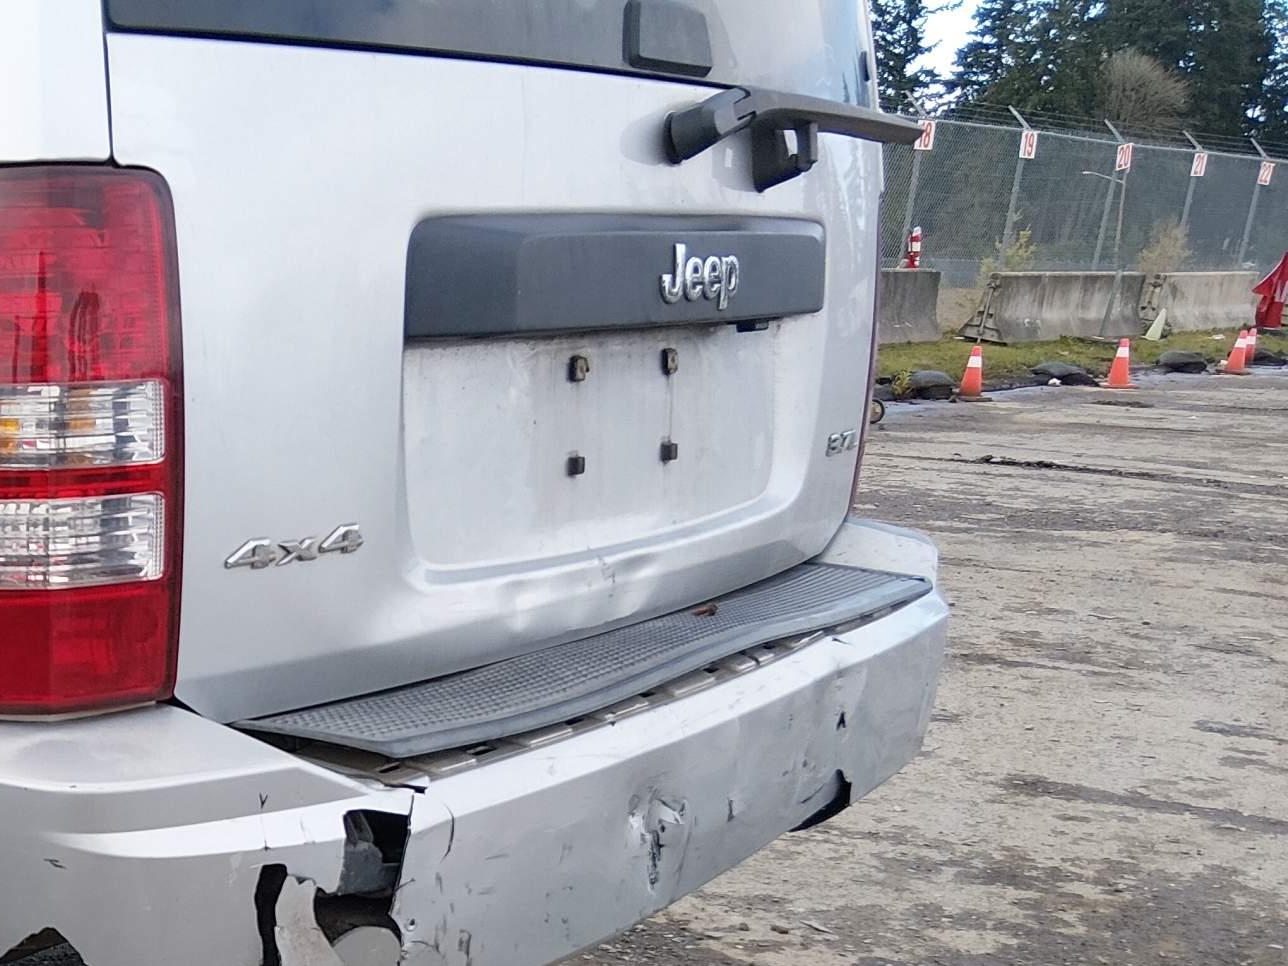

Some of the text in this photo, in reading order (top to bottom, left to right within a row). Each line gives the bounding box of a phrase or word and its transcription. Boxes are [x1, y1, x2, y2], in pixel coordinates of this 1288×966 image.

[1023, 132, 1035, 157] 19
[1117, 144, 1131, 169] 20
[1193, 154, 1206, 176] 21
[1259, 162, 1273, 184] 22
[660, 242, 739, 310] Jeep
[224, 523, 364, 570] 4x4
